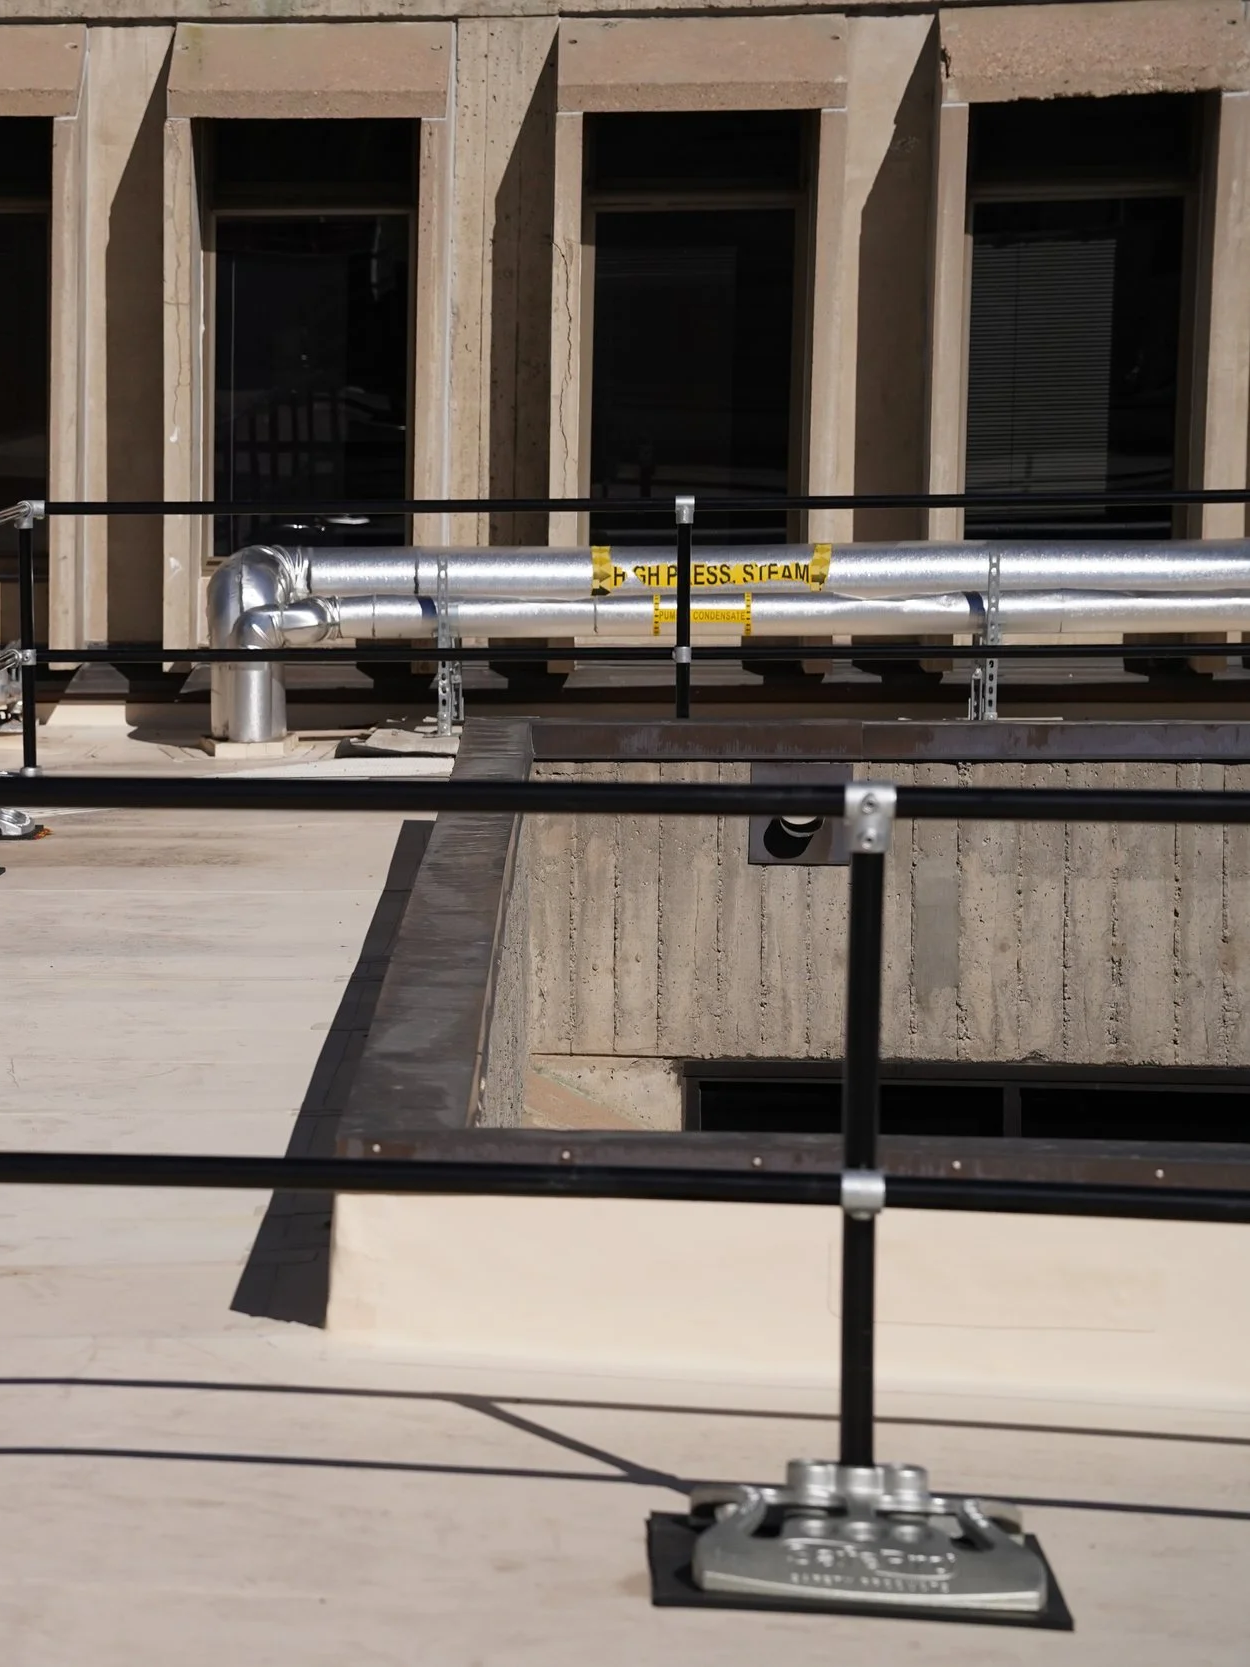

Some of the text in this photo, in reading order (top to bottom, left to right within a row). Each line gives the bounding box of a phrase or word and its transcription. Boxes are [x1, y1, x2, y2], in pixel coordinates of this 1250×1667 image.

[613, 562, 810, 586] HGH PESS. STEAM
[659, 610, 746, 621] PUM CONDENSATE
